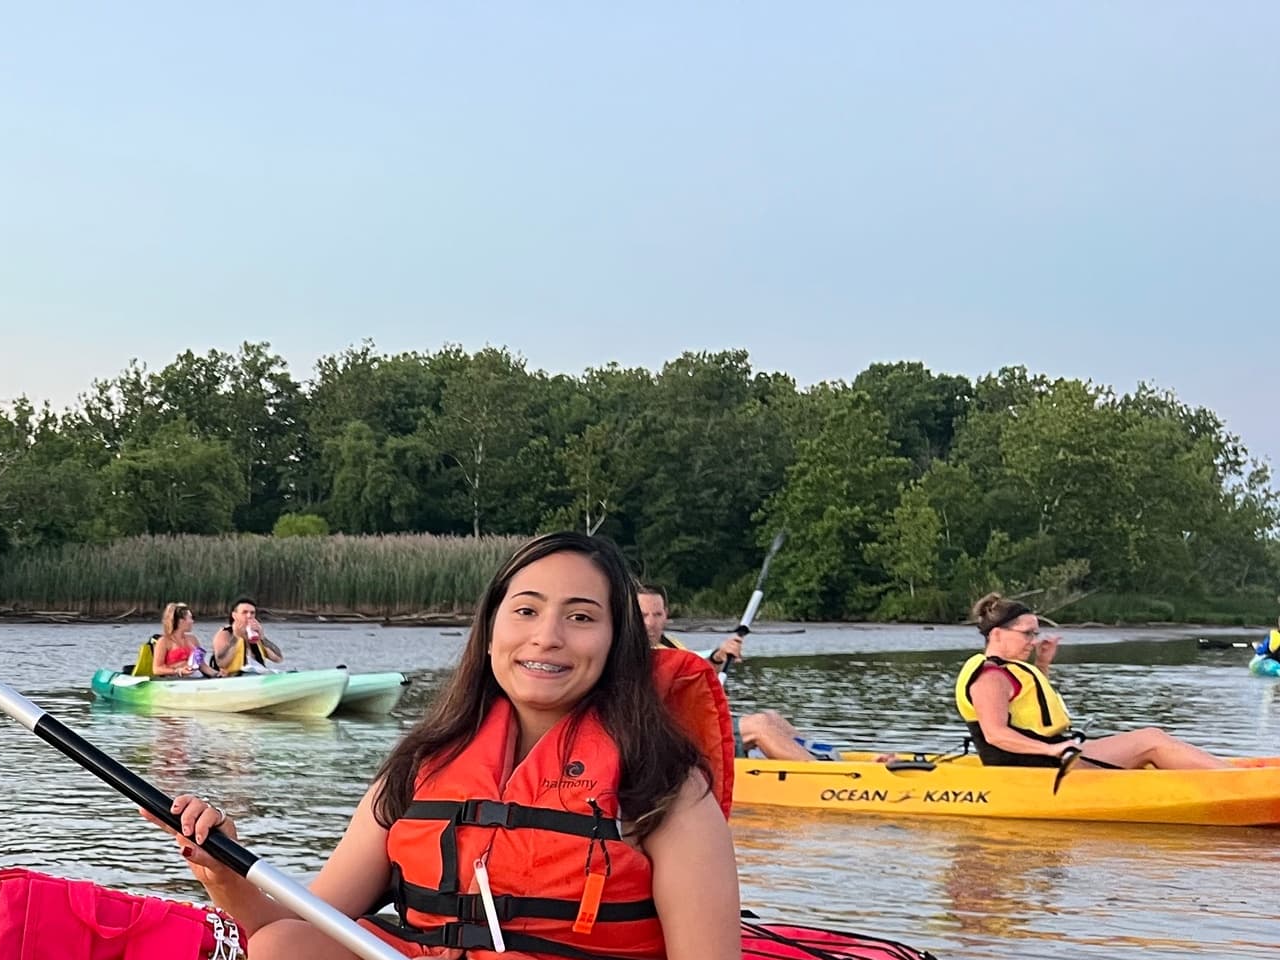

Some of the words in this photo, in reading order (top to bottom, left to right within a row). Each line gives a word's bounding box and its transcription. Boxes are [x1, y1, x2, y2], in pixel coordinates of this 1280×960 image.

[542, 778, 598, 790] harmony
[820, 788, 888, 801] OCEAN
[923, 789, 991, 803] KAYAK
